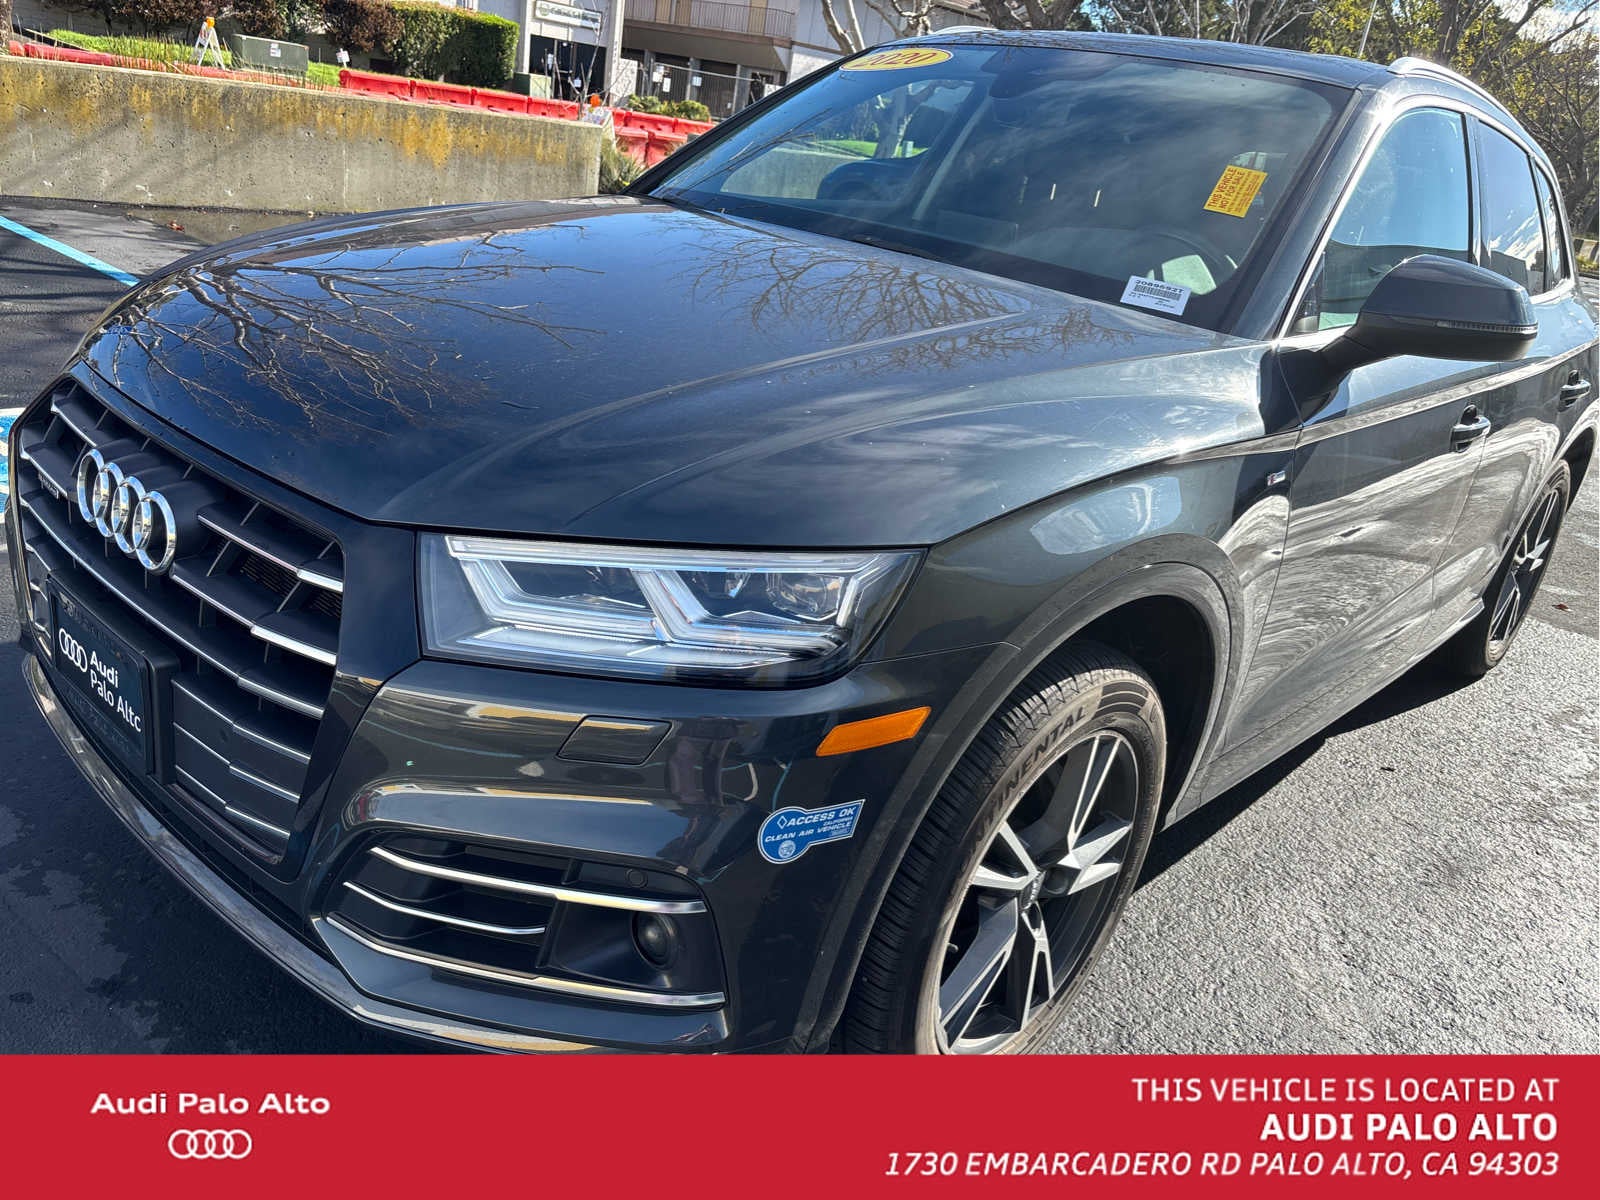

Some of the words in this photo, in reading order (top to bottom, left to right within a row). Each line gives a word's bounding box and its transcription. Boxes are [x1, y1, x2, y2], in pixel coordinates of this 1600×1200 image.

[850, 52, 938, 67] 2020
[1217, 168, 1237, 192] VEHICLE
[90, 650, 119, 688] Audi
[90, 668, 115, 707] Palo
[787, 811, 835, 827] ACCESS
[838, 806, 857, 817] OK
[765, 831, 796, 843] CLEAN
[798, 828, 815, 838] AIR
[817, 821, 852, 833] VEHICLE
